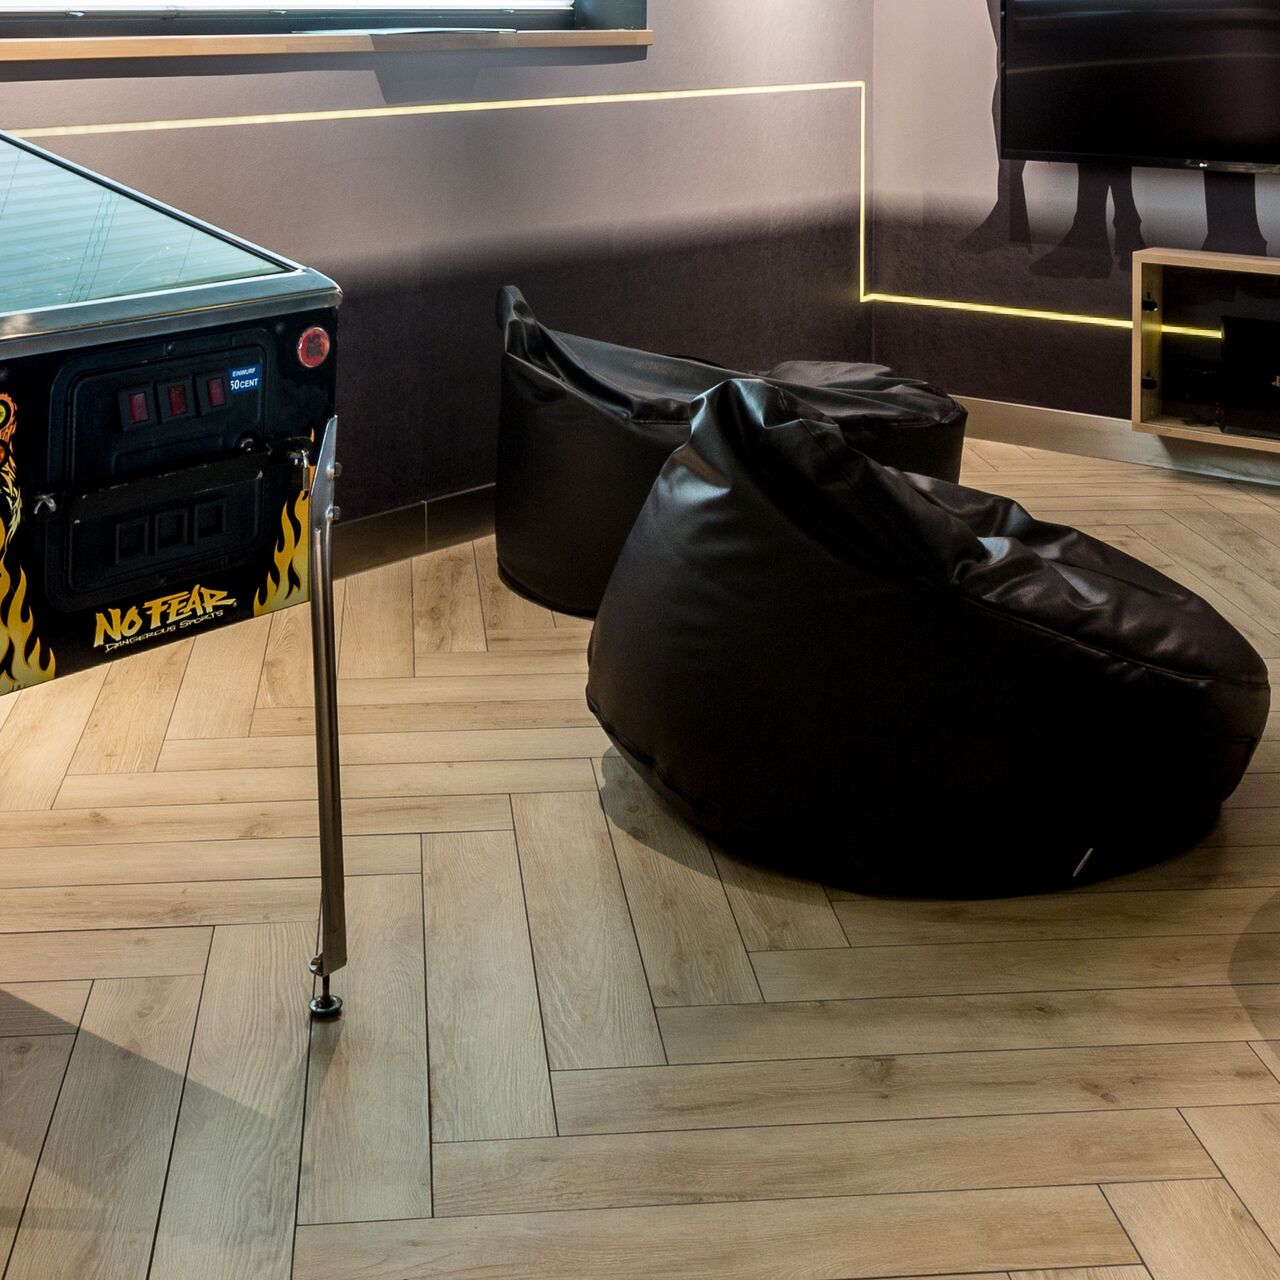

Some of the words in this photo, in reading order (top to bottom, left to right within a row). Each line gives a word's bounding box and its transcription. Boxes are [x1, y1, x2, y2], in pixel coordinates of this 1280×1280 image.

[93, 605, 143, 648] NO
[142, 584, 236, 629] FEAR
[105, 624, 177, 653] DANGEROUS
[179, 609, 224, 629] SPORTS
